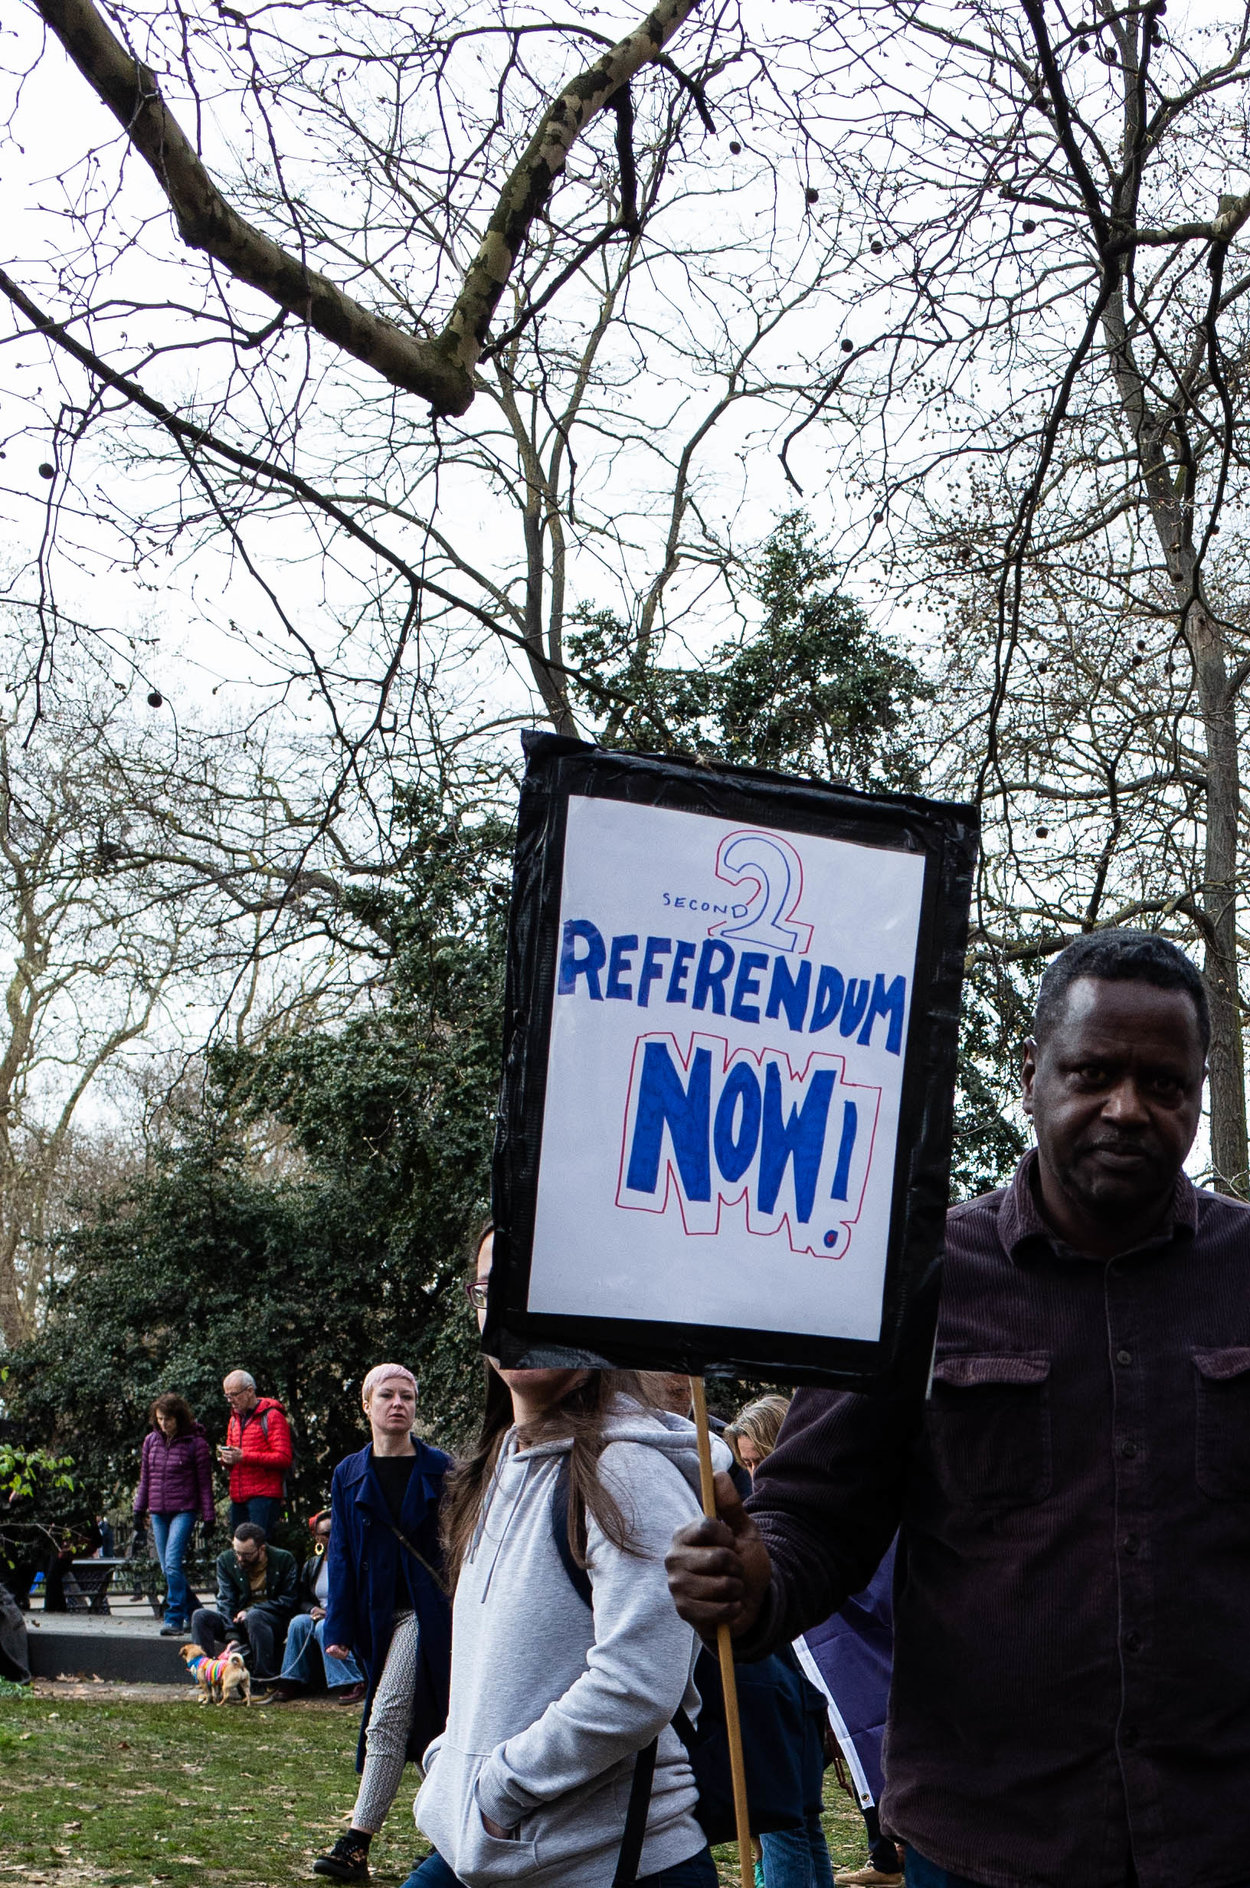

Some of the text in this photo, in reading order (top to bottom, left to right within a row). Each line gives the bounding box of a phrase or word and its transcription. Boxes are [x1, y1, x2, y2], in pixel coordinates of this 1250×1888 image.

[662, 892, 749, 919] SECOND
[708, 829, 815, 954] 2
[556, 918, 907, 1057] REFERENDUM
[624, 1040, 860, 1252] NOW!
